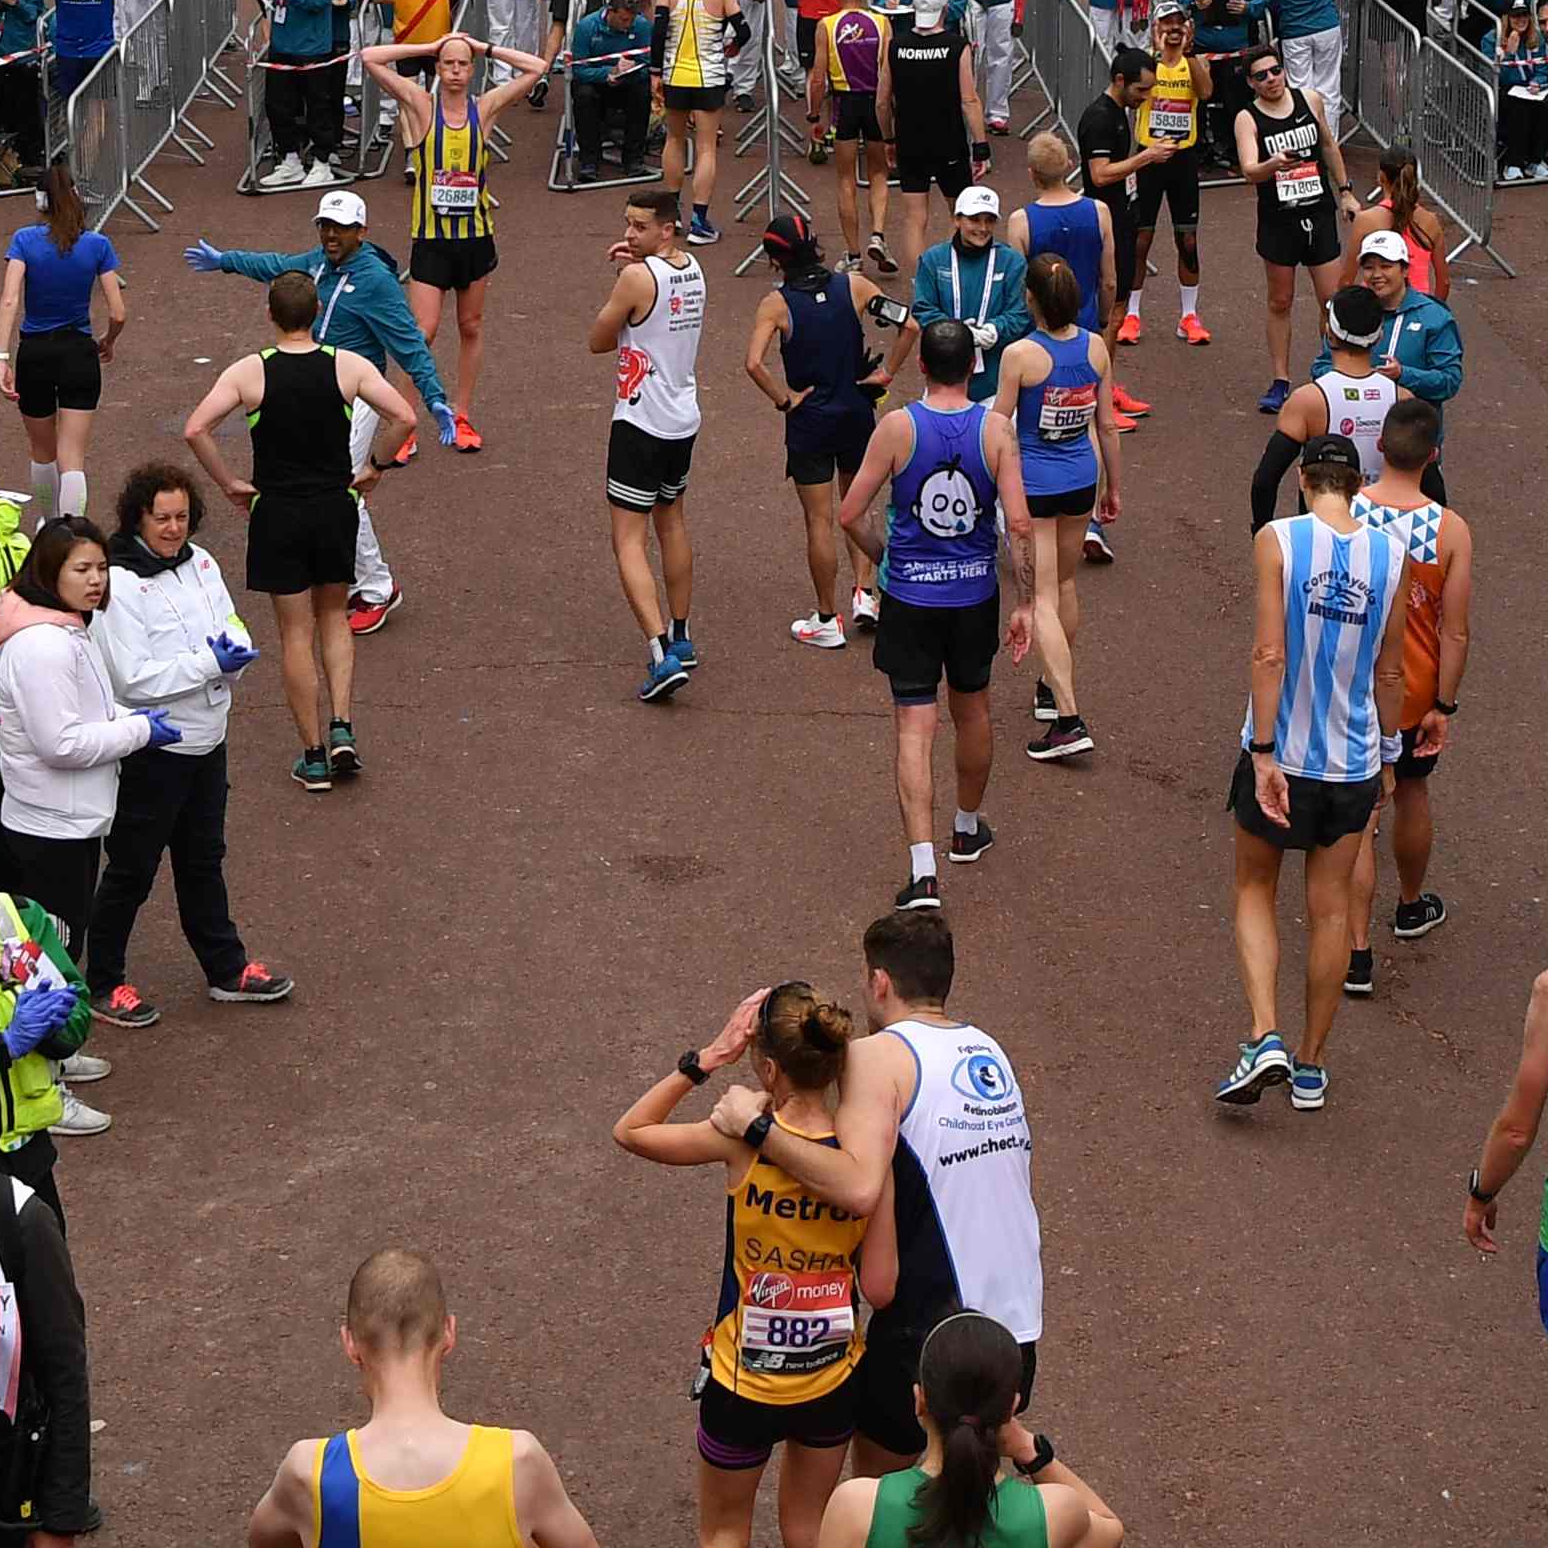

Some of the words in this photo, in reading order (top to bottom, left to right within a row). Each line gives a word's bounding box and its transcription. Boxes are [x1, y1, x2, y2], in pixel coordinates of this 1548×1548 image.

[897, 47, 950, 61] NORWAY
[1154, 113, 1190, 129] 58385
[437, 189, 475, 205] 26884
[1282, 178, 1320, 198] 71805
[938, 1116, 985, 1132] Childhood
[987, 1115, 1005, 1132] Eye
[746, 1183, 854, 1223] Metro
[746, 1237, 849, 1272] SASHA
[752, 1272, 791, 1309] Virgin
[796, 1281, 845, 1305] money
[767, 1316, 831, 1348] 882
[785, 1361, 803, 1372] new
